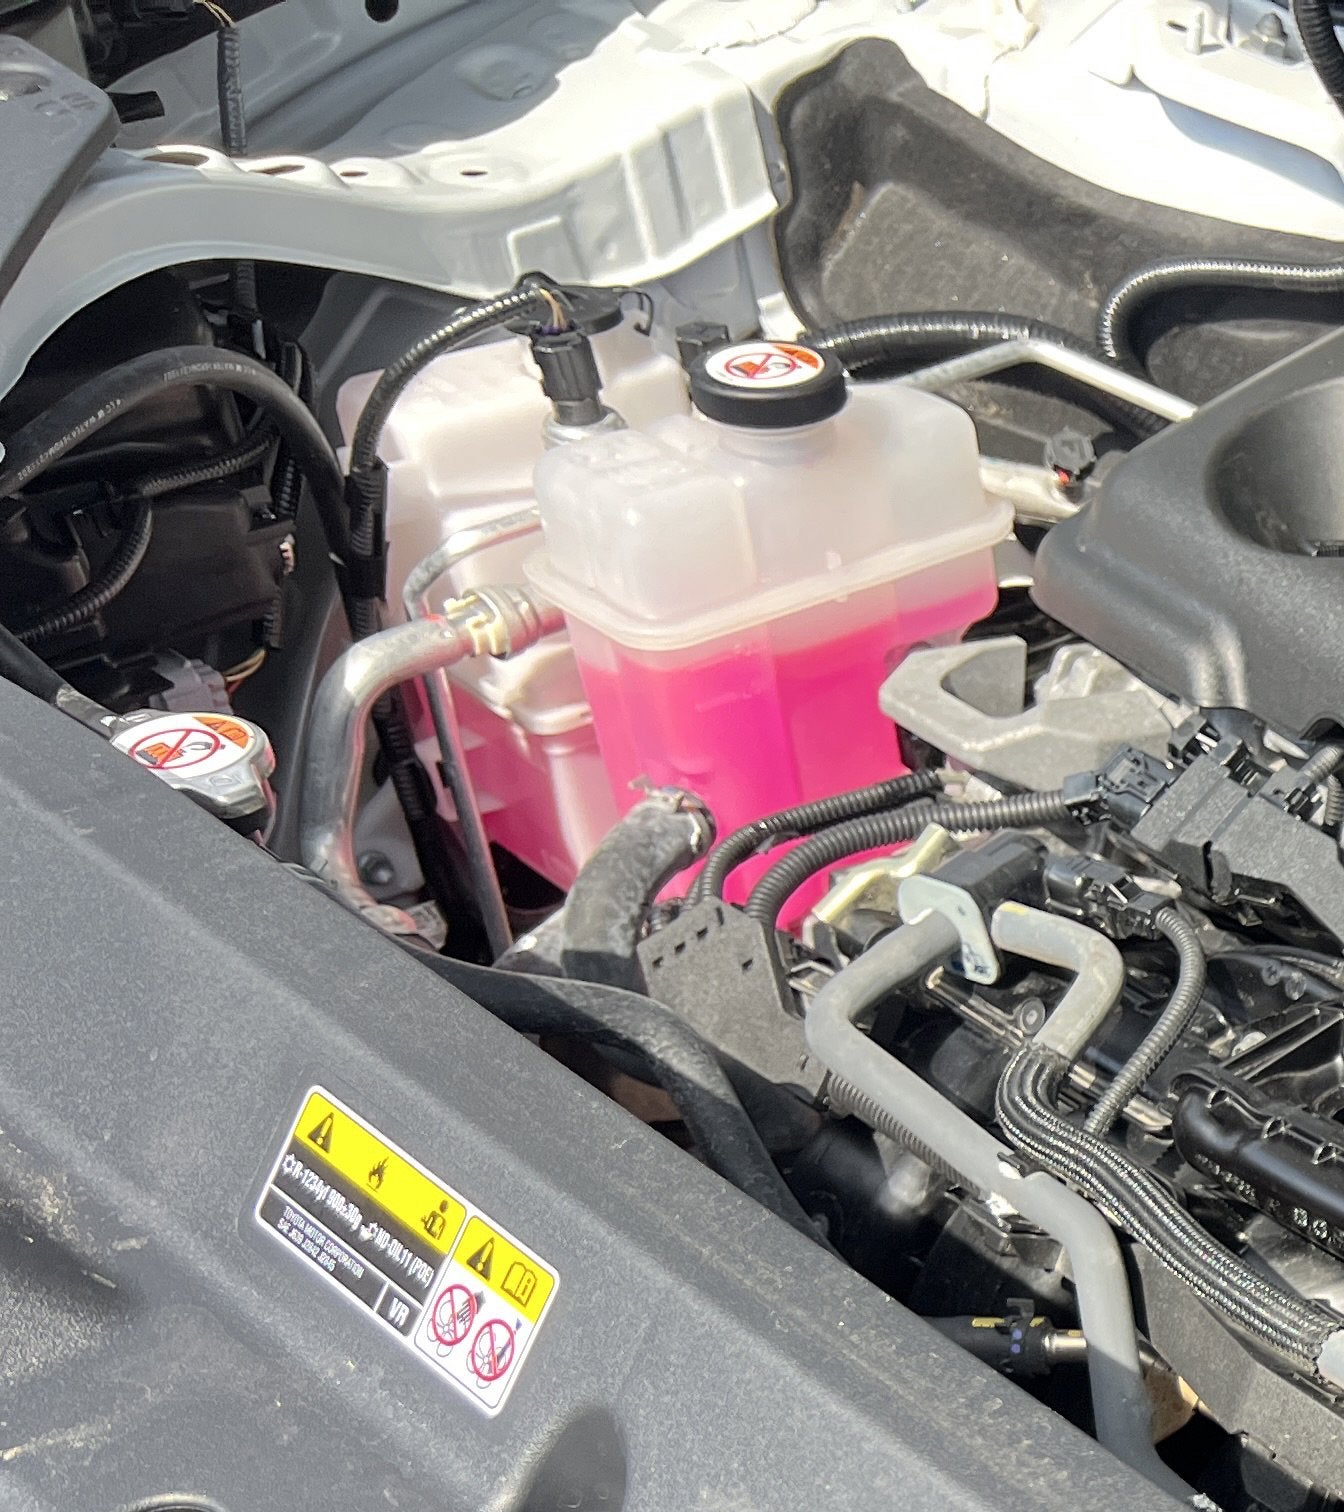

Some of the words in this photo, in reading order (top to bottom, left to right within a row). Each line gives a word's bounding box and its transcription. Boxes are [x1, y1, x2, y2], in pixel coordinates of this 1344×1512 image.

[281, 1205, 306, 1230] TOYOTA
[302, 1222, 325, 1247] MOTOR
[323, 1239, 363, 1279] CORPORATION
[386, 1297, 410, 1328] VR
